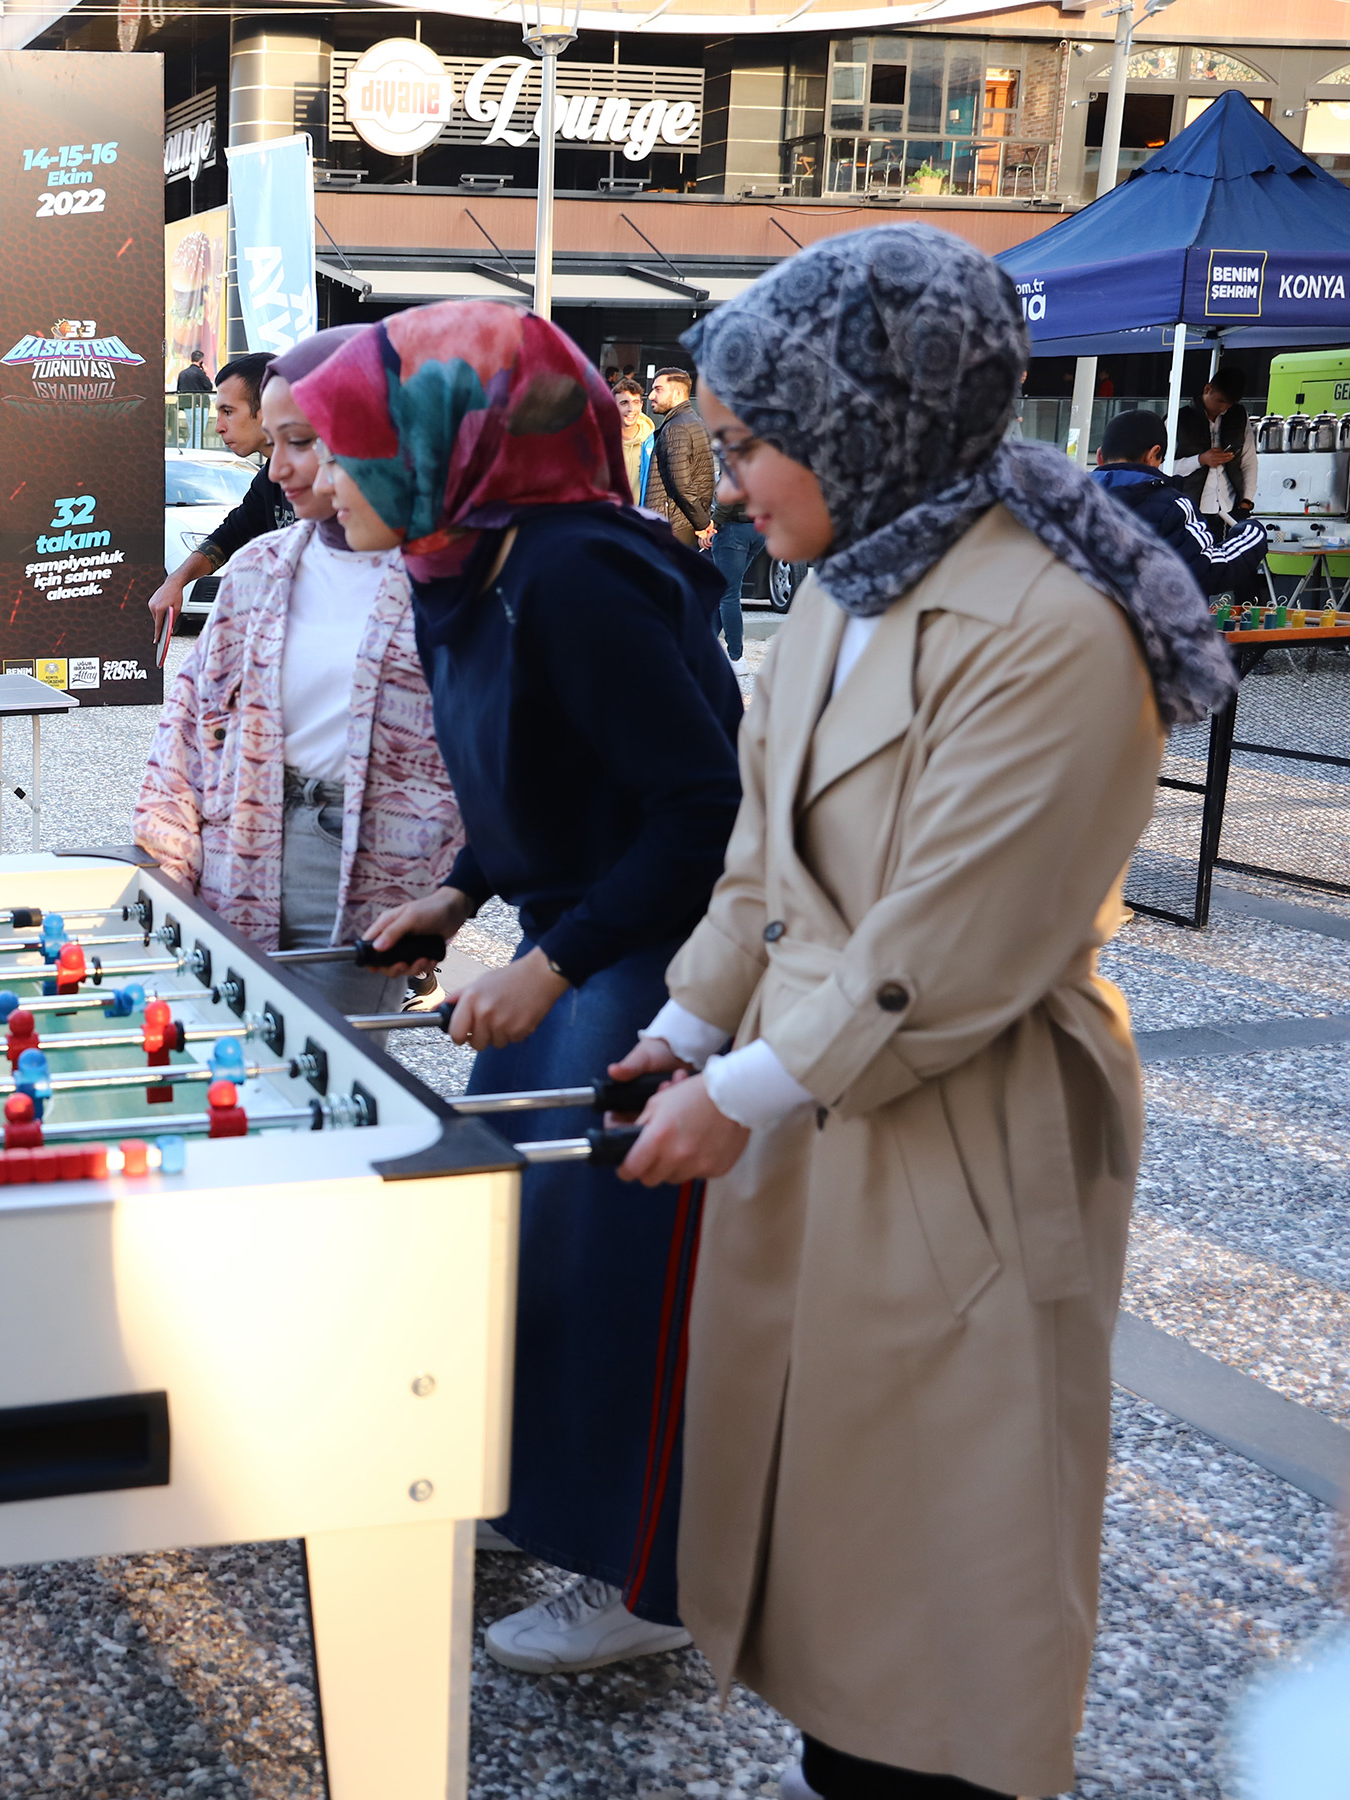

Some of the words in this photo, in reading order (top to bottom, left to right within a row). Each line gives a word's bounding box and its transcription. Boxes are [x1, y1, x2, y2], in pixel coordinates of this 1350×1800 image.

[464, 55, 698, 162] Lounge
[22, 141, 119, 171] 14-15-16
[47, 167, 94, 187] Ekim
[35, 188, 107, 218] 2022
[1278, 274, 1345, 299] KONYA
[0, 334, 147, 366] BASKETBOL
[31, 360, 116, 380] TURNUVASI
[50, 494, 97, 528] 32
[35, 529, 111, 555] takım
[25, 549, 126, 578] şampiyonluk
[33, 572, 63, 592] için
[64, 568, 113, 585] sahne
[46, 582, 104, 602] alacak.
[102, 660, 139, 672] SPOR
[103, 669, 148, 681] KONYA
